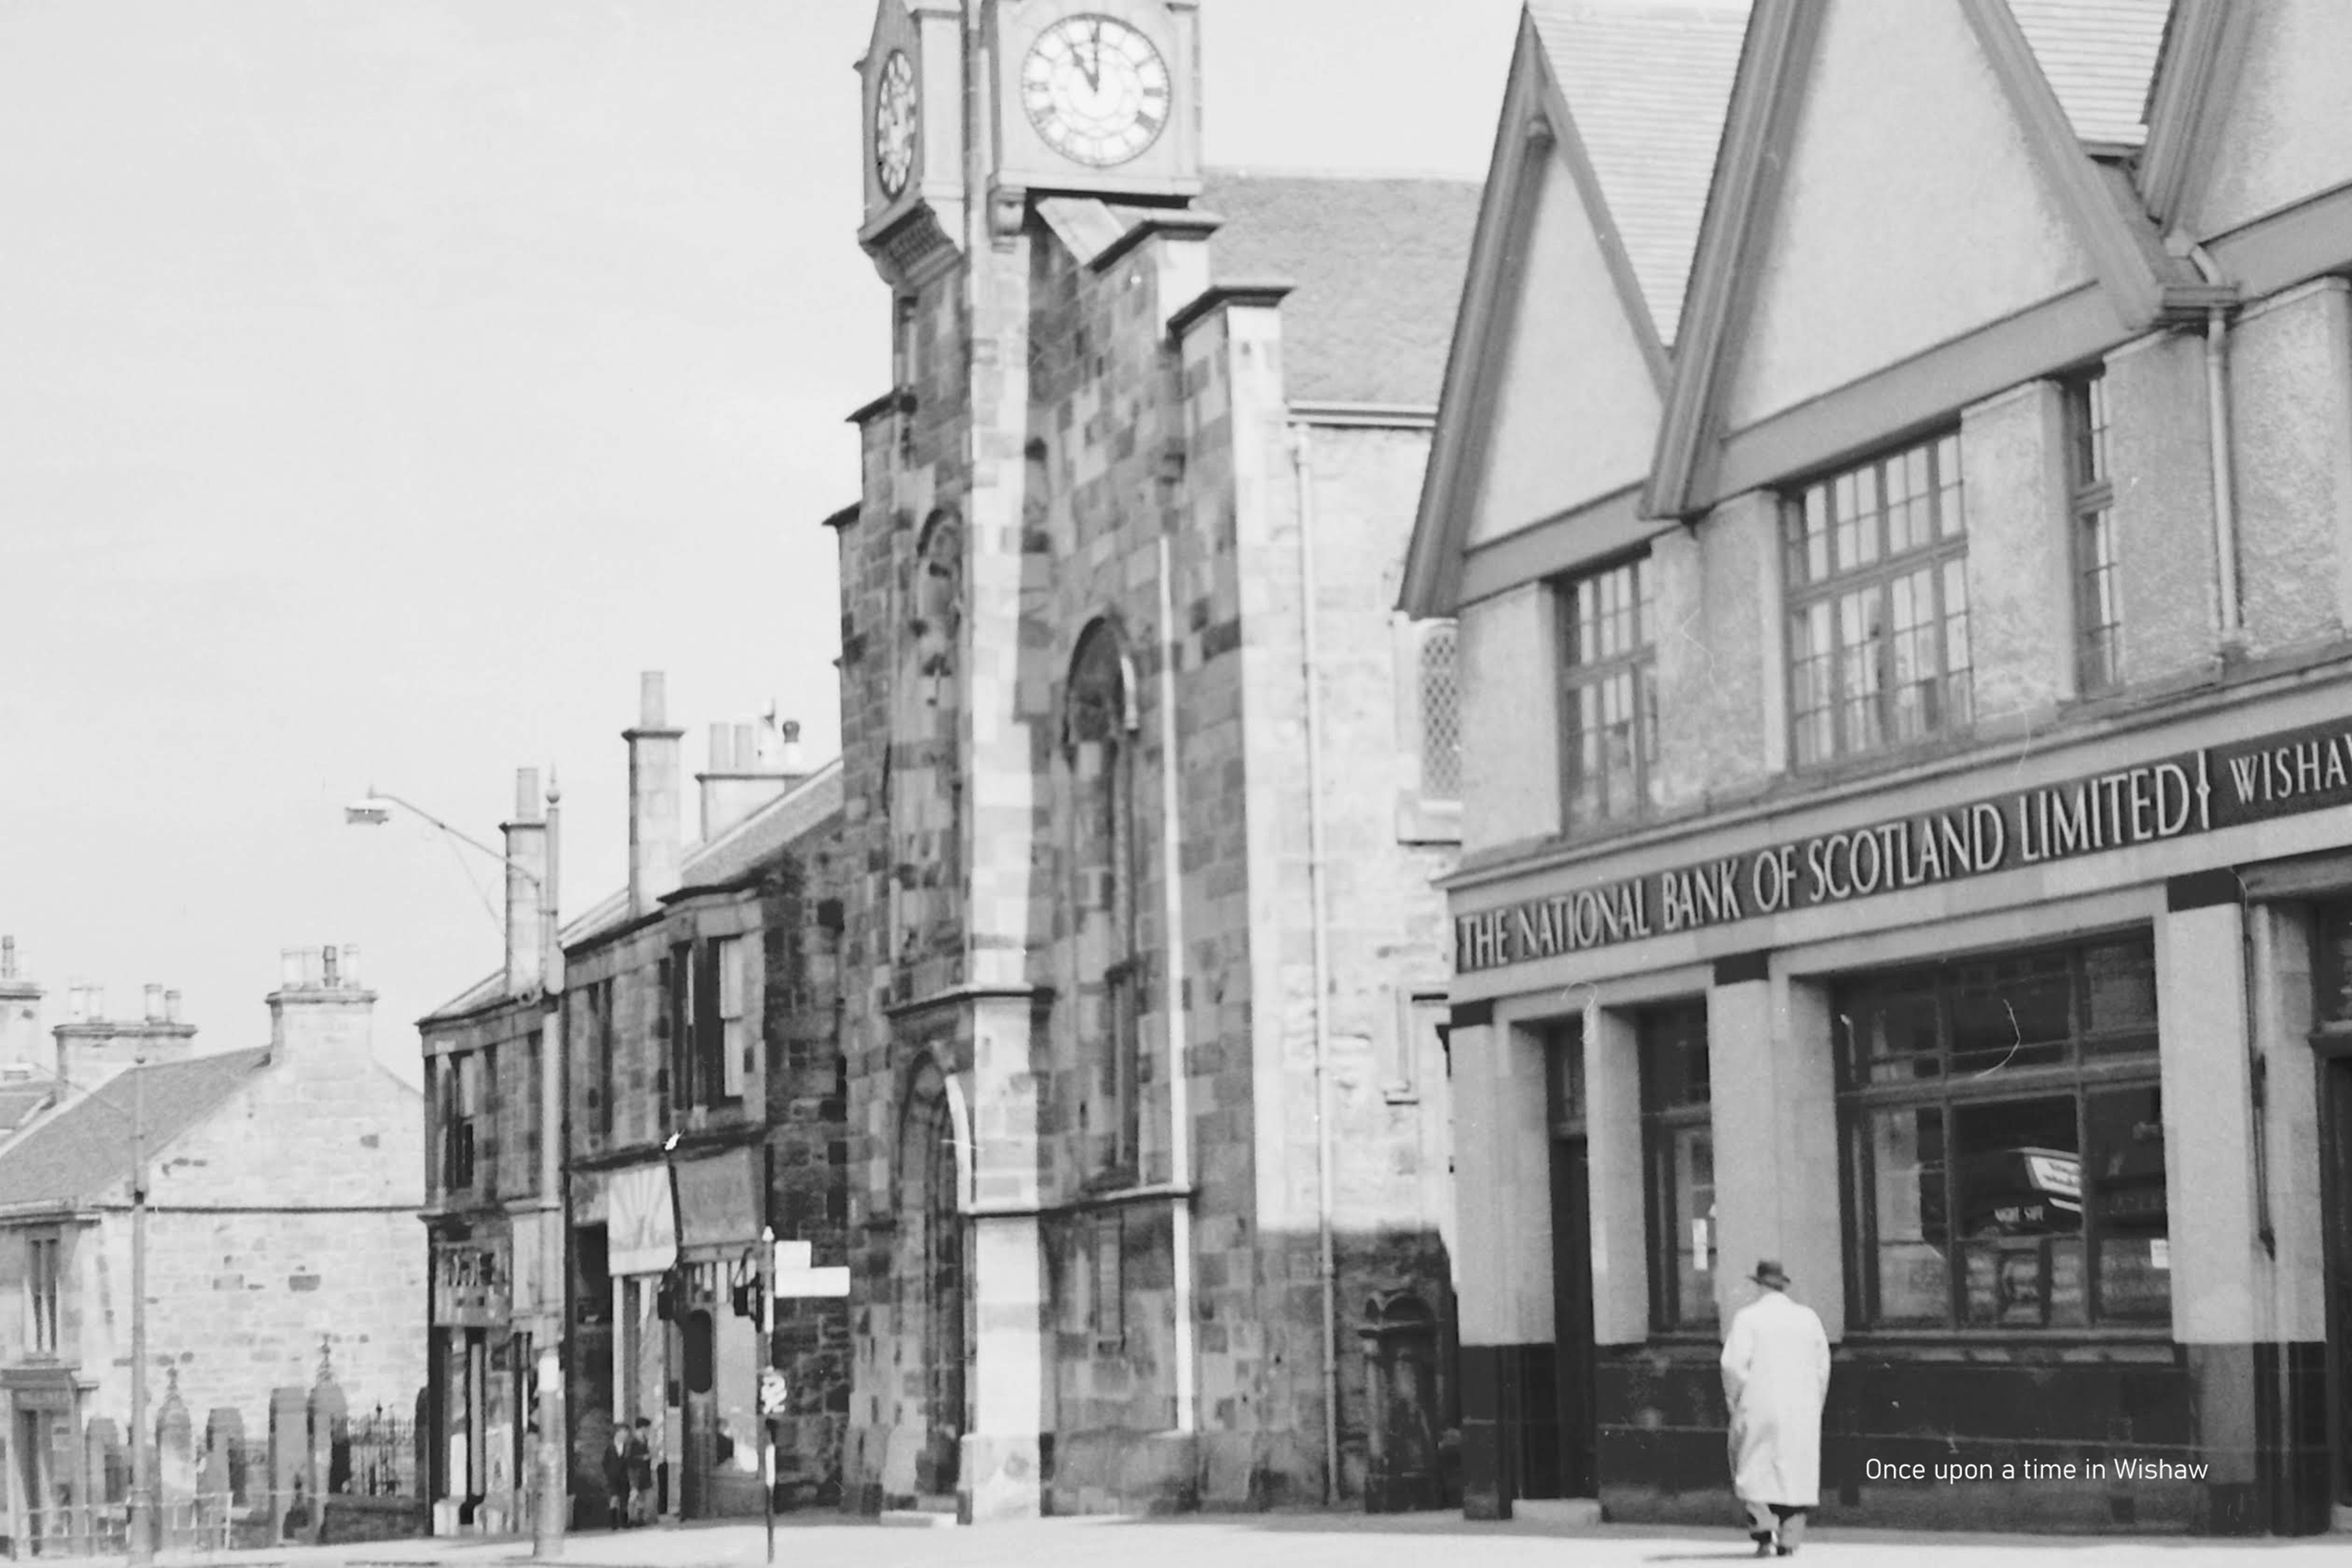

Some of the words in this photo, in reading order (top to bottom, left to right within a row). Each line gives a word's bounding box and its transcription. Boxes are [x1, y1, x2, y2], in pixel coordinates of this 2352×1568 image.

[2228, 733, 2352, 805] WISHA
[1459, 908, 1508, 968] THE
[1517, 877, 1651, 960] NATIONAL
[1661, 858, 1741, 932] BANK
[1752, 844, 1797, 914] OF
[1808, 801, 2004, 902] SCOTLAND
[2019, 763, 2191, 863] LIMITED
